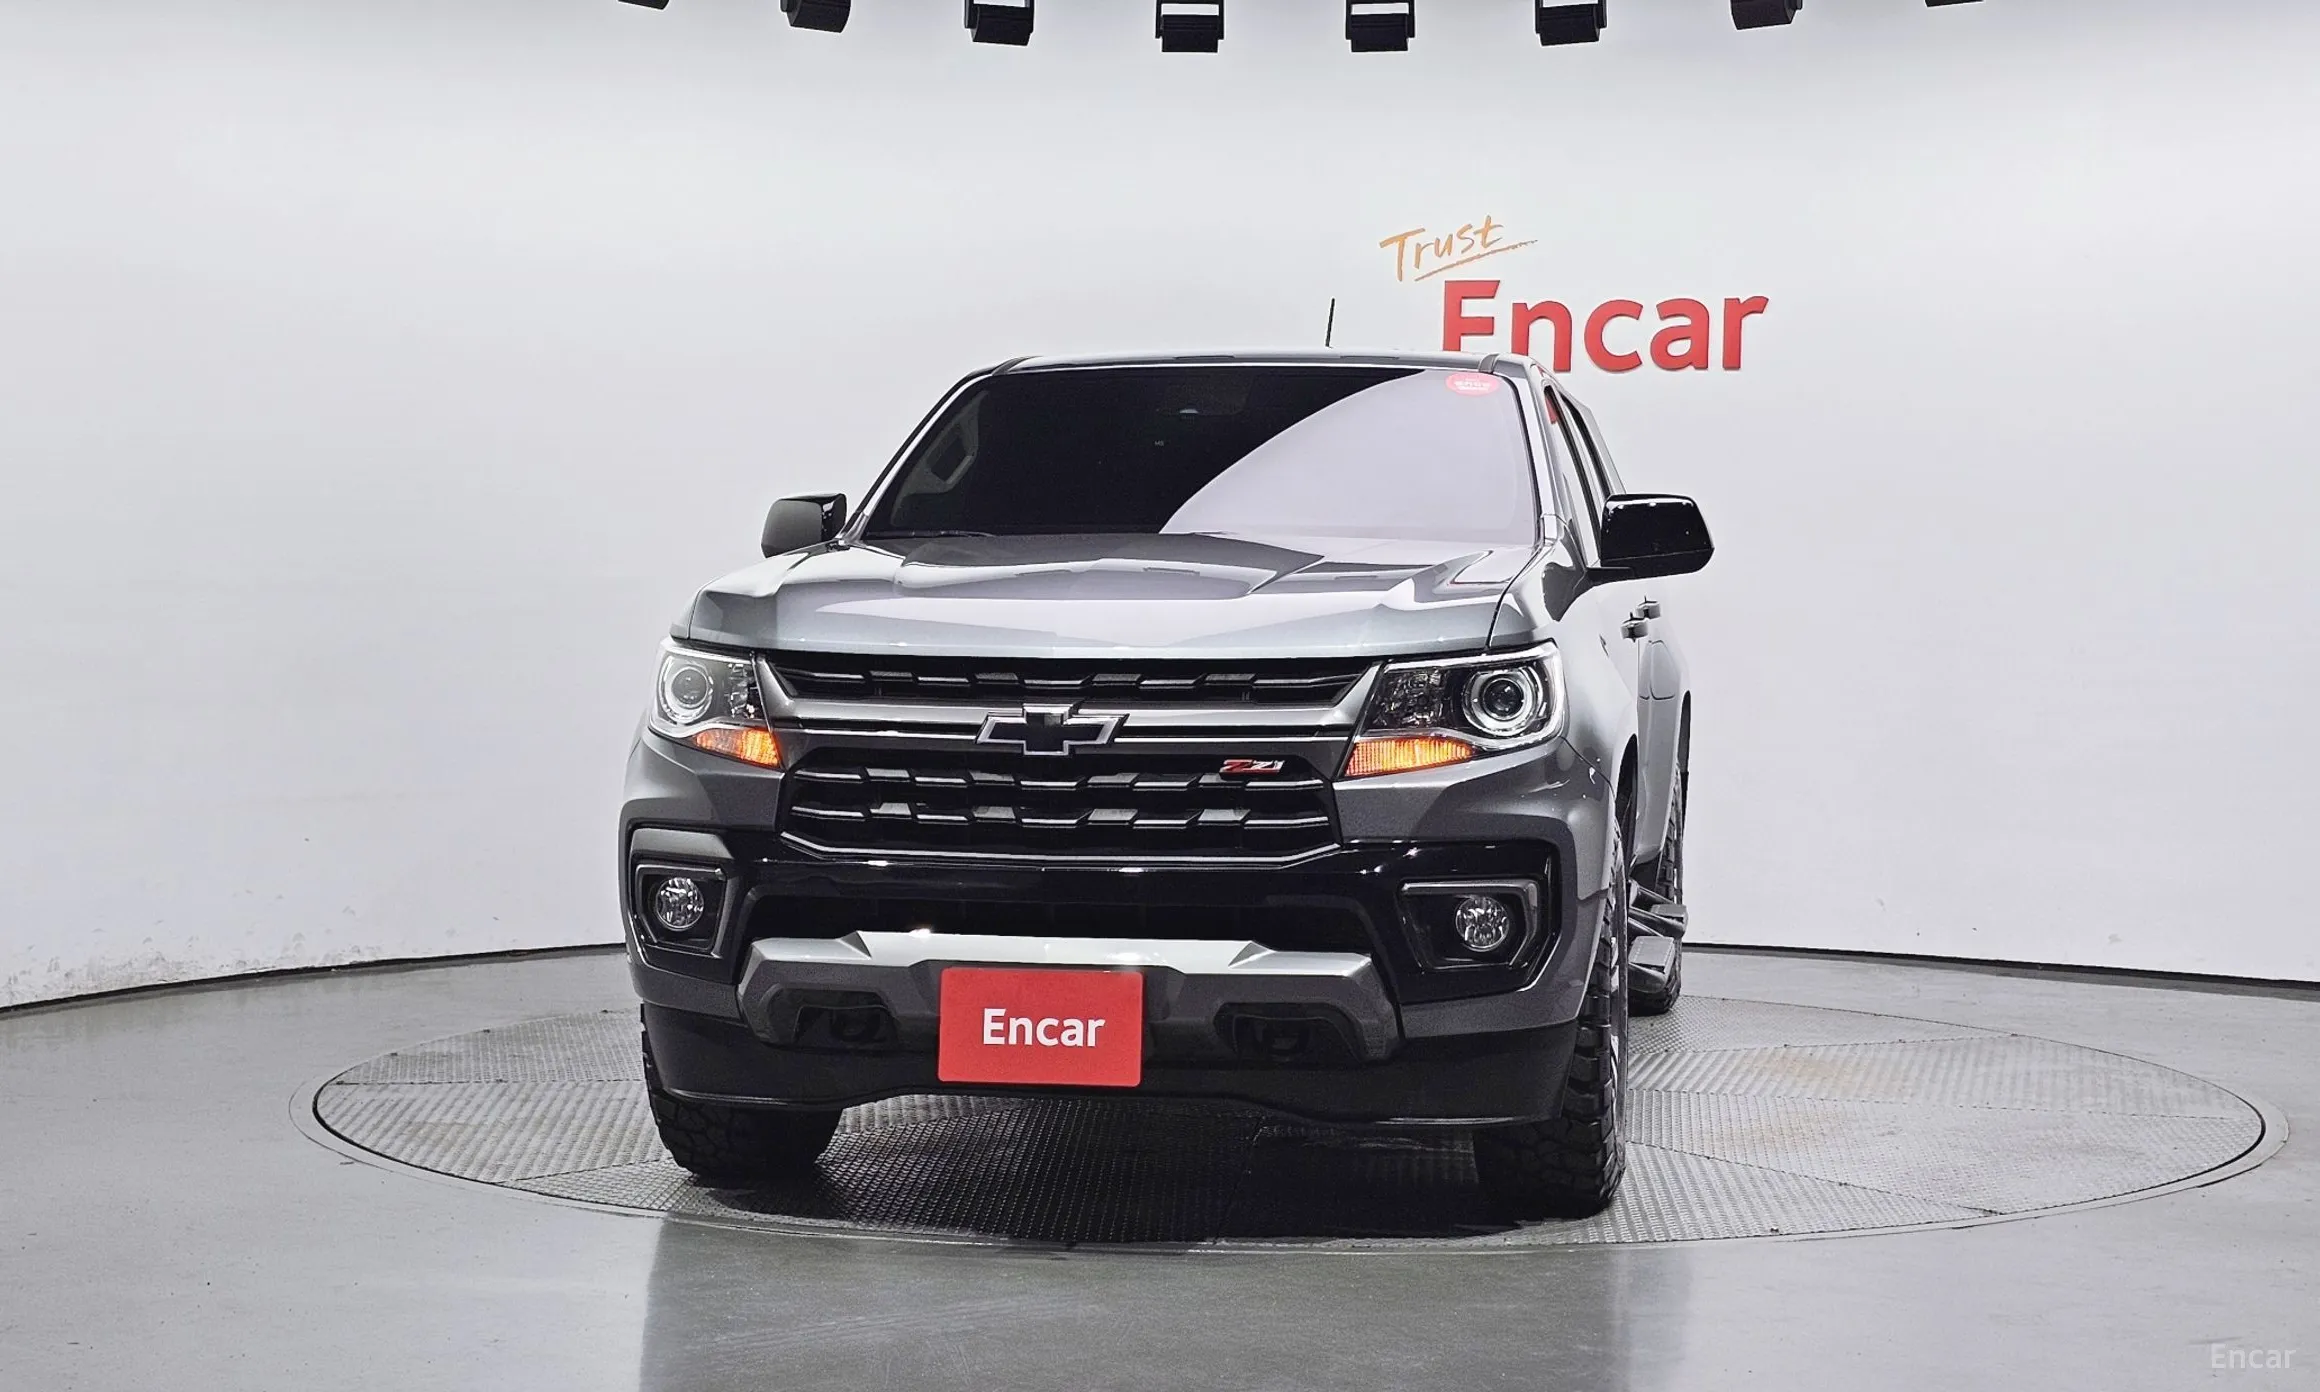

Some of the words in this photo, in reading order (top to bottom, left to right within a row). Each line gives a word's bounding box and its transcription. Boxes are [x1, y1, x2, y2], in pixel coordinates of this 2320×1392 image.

[1379, 214, 1504, 282] Trust
[1442, 279, 1769, 372] Encar
[982, 1007, 1106, 1047] Encar
